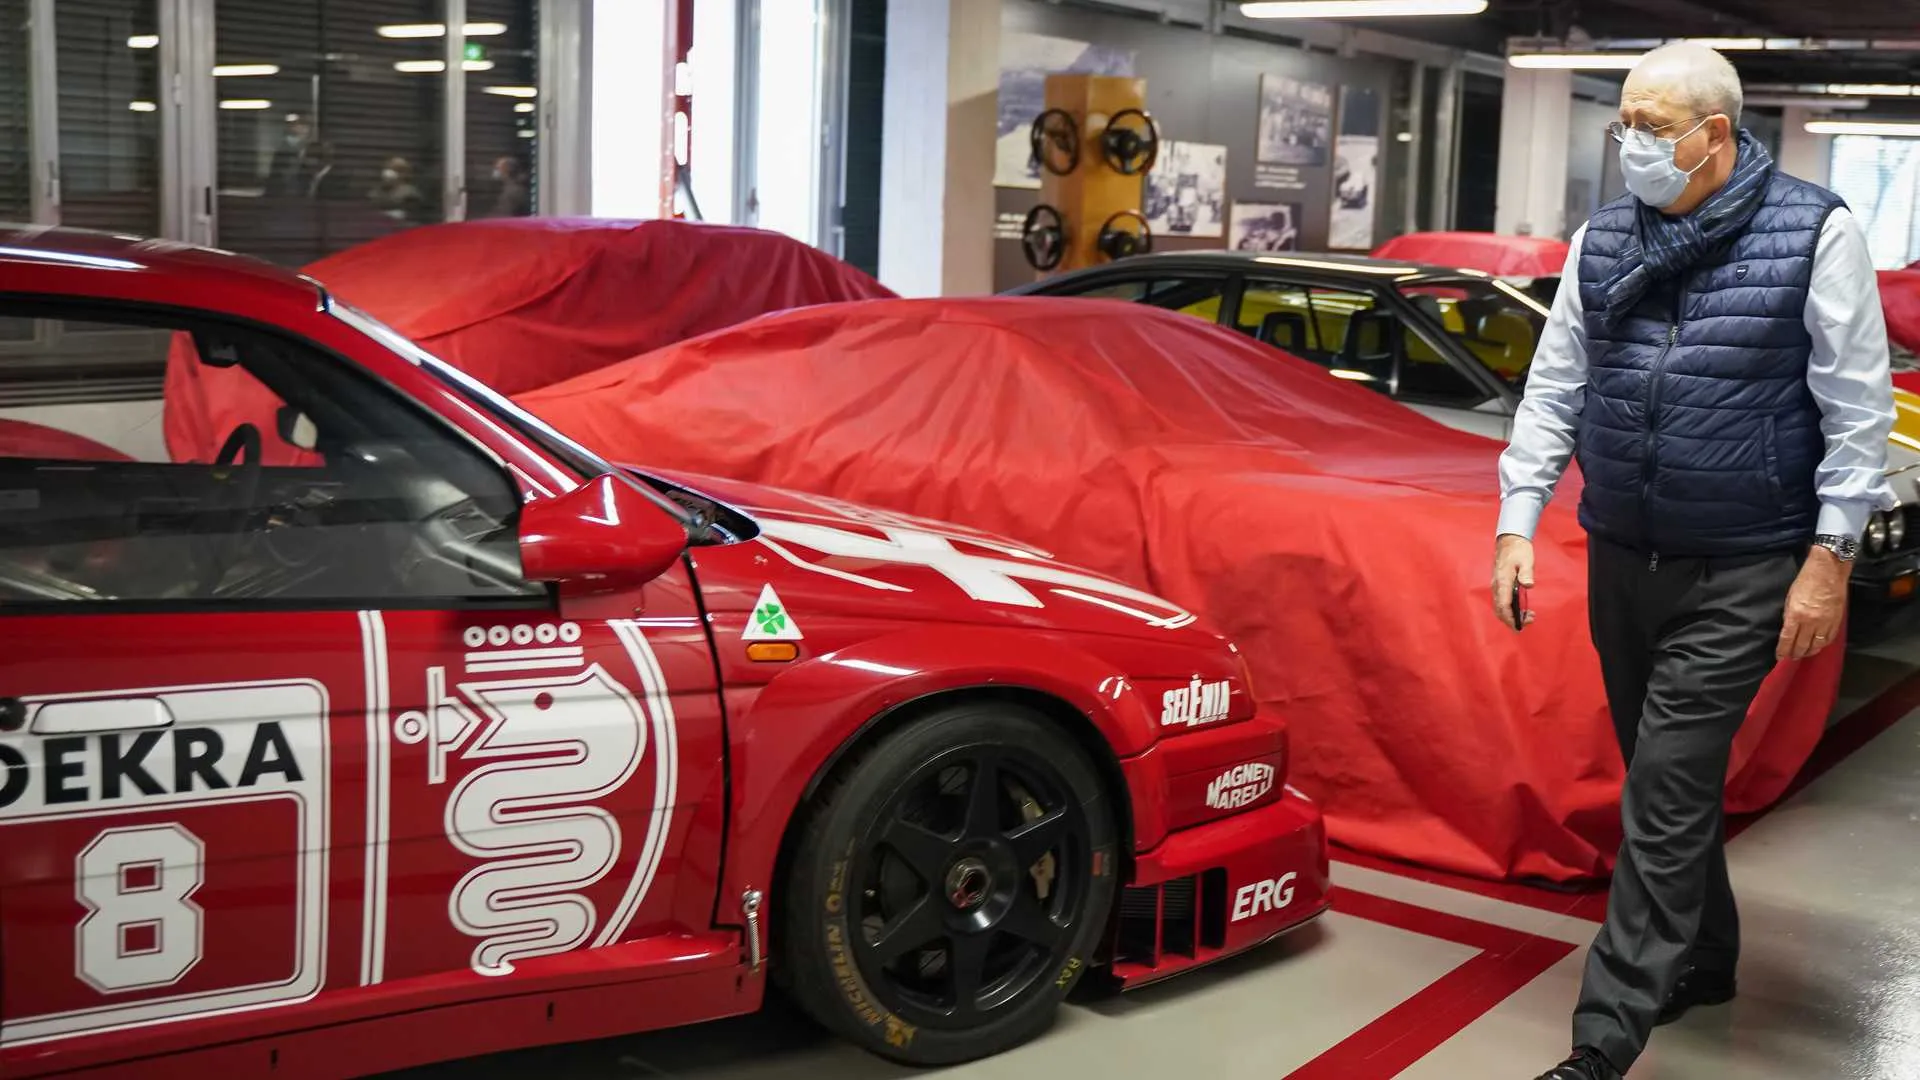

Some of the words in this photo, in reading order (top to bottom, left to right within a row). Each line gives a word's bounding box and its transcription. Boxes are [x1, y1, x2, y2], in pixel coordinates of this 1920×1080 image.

[1206, 779, 1273, 809] MARELLI
[1207, 762, 1275, 793] MAGNETI
[74, 821, 206, 996] 8
[1231, 871, 1297, 922] ERG
